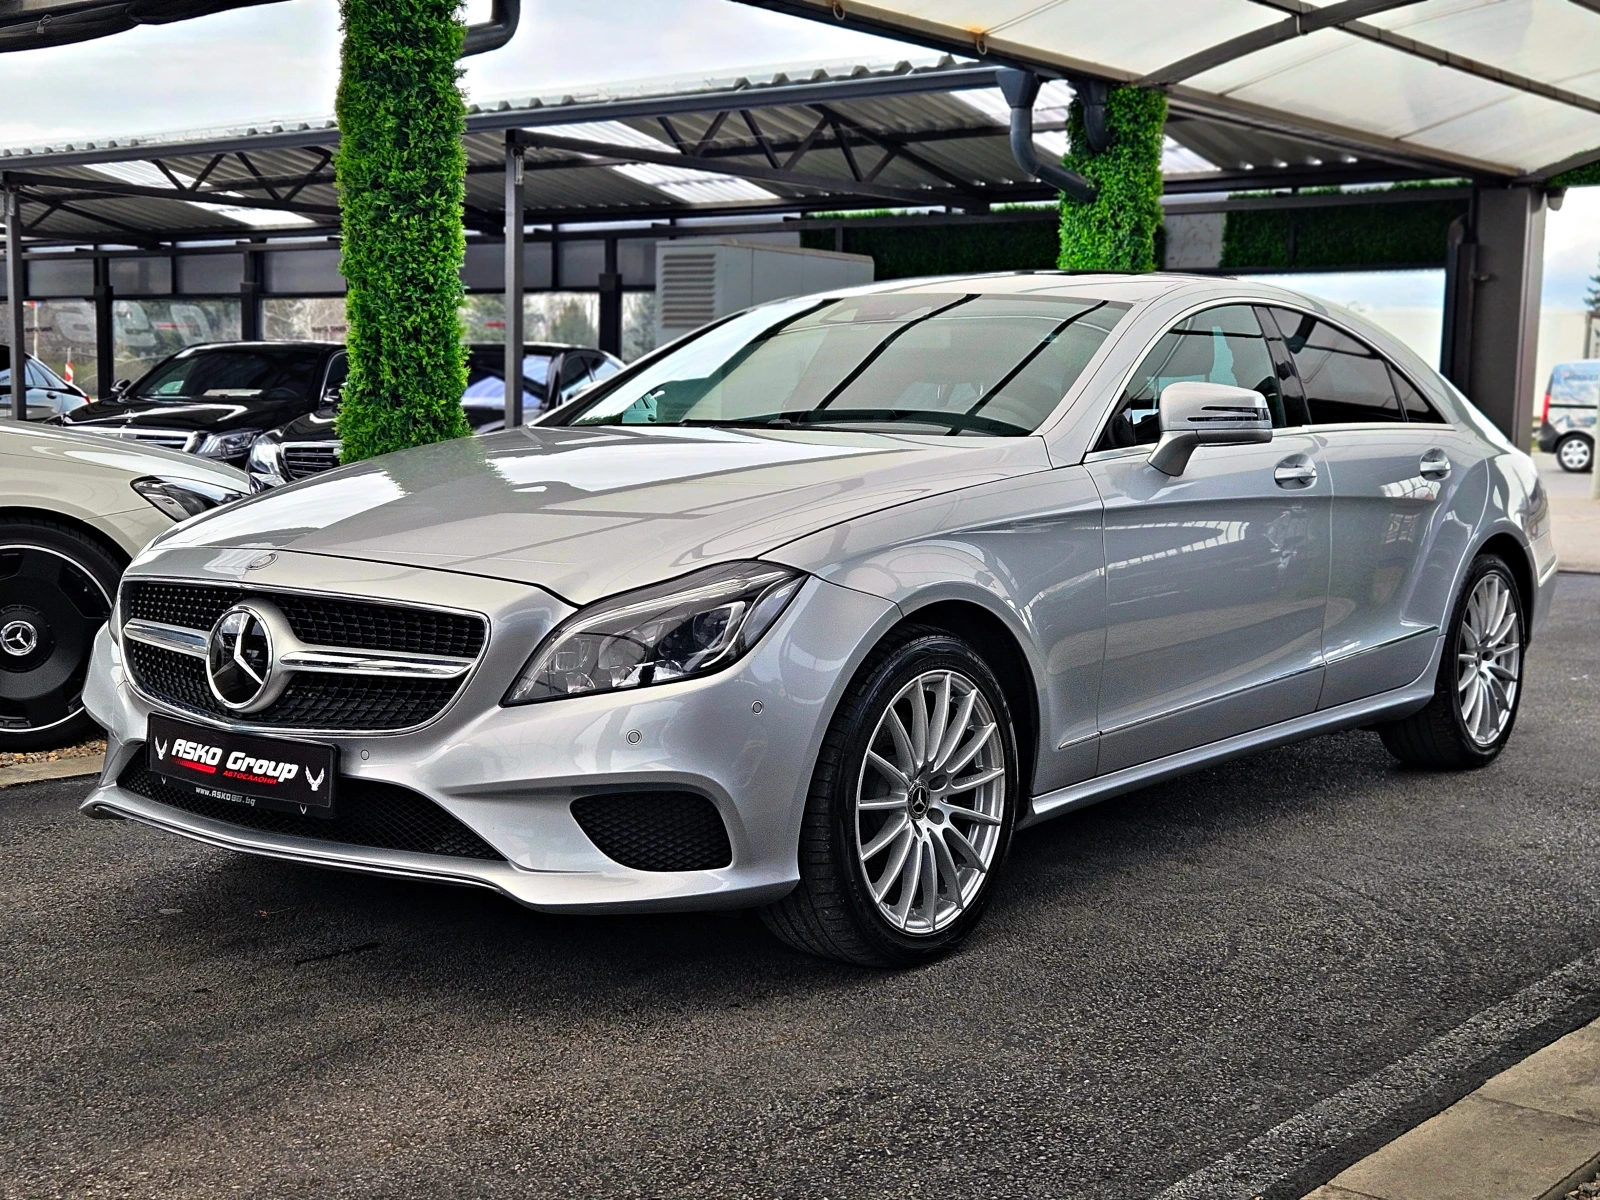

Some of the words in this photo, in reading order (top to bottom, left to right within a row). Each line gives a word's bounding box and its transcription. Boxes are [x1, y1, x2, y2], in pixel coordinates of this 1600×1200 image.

[171, 738, 222, 766] ASKO
[226, 751, 299, 782] Group
[222, 770, 277, 785] АВТОСАЛОНИ
